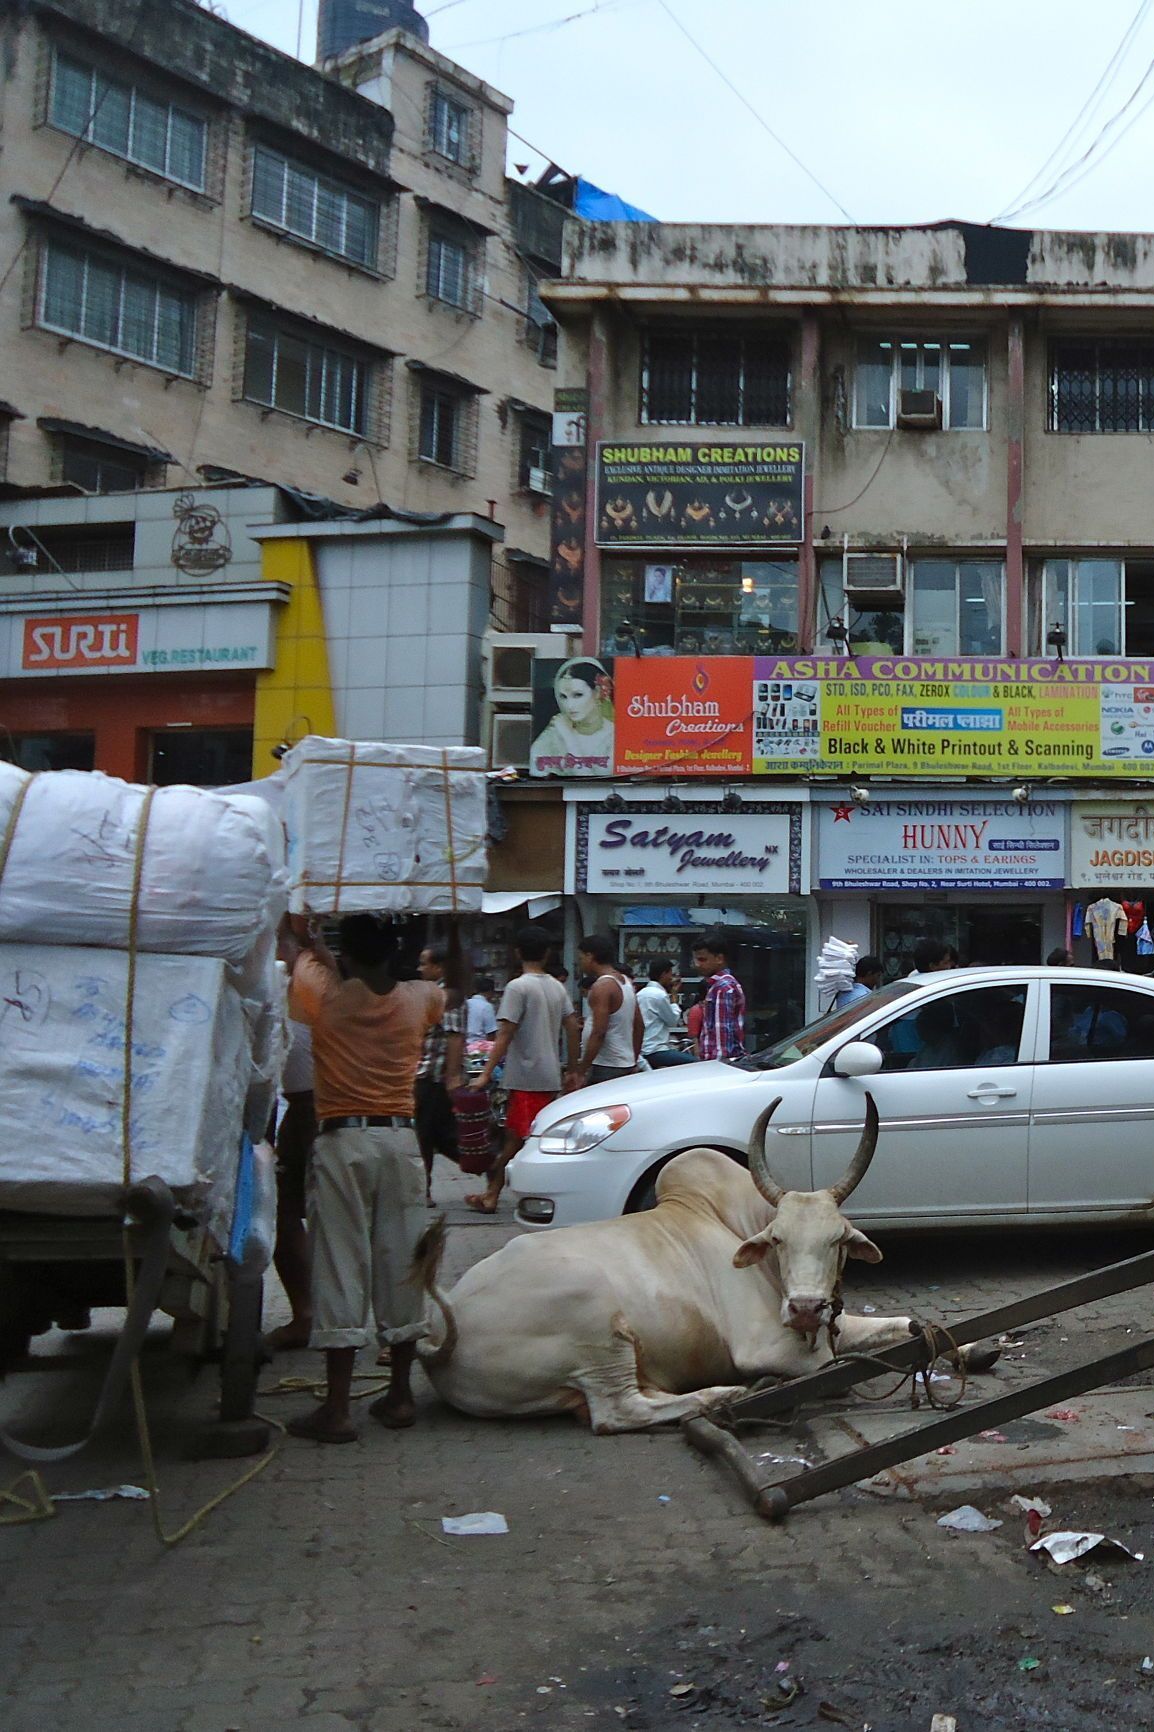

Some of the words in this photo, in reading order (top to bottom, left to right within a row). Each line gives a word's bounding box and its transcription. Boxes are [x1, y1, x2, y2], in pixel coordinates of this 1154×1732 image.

[602, 447, 692, 464] SHUBHAM
[698, 447, 800, 464] CREATIONS
[644, 465, 674, 474] ANTIQUE
[676, 465, 712, 474] DESIGNER
[756, 465, 796, 474] JEWELLERY
[770, 661, 862, 680] ASHA
[872, 659, 1150, 682] COMMUNICATION
[920, 685, 950, 698] ZEROX
[993, 686, 1000, 698] &
[1039, 686, 1098, 698] LAMINATION
[628, 694, 720, 718] Shubham
[836, 705, 850, 717] All
[855, 705, 882, 717] Types
[886, 705, 898, 717] of
[1008, 706, 1024, 718] All
[1026, 706, 1050, 718] Types
[1054, 706, 1064, 718] of
[823, 720, 852, 732] Refill
[855, 720, 896, 732] Voucher
[903, 710, 952, 730] परीमल
[1008, 720, 1038, 732] Mobile
[1044, 720, 1099, 732] Accessories
[666, 719, 744, 736] Creations
[828, 738, 871, 755] Black
[874, 739, 886, 755] &
[892, 738, 936, 755] White
[941, 738, 1002, 756] Printout
[1008, 740, 1018, 756] &
[1026, 740, 1094, 759] Scanning
[624, 750, 662, 762] Designer
[700, 750, 742, 763] Jewellery
[852, 762, 884, 770] Parimal
[1122, 762, 1137, 770] 400
[860, 803, 890, 816] SAI
[896, 803, 953, 816] SINDHI
[960, 803, 1056, 816] SELECTION
[599, 820, 736, 856] Satyam
[902, 820, 989, 849] HUNNY
[676, 850, 770, 872] Jewellery
[764, 845, 779, 854] NX
[848, 855, 916, 864] SPECIALIST
[920, 855, 933, 864] IN:
[938, 855, 967, 864] TOPS
[971, 855, 979, 864] &
[984, 855, 1036, 864] EARINGS
[832, 880, 843, 888] 9th
[901, 880, 917, 888] Shop
[940, 880, 955, 888] Near
[957, 880, 972, 888] Surti
[993, 880, 1018, 888] Mumbai
[1024, 880, 1036, 888] 400
